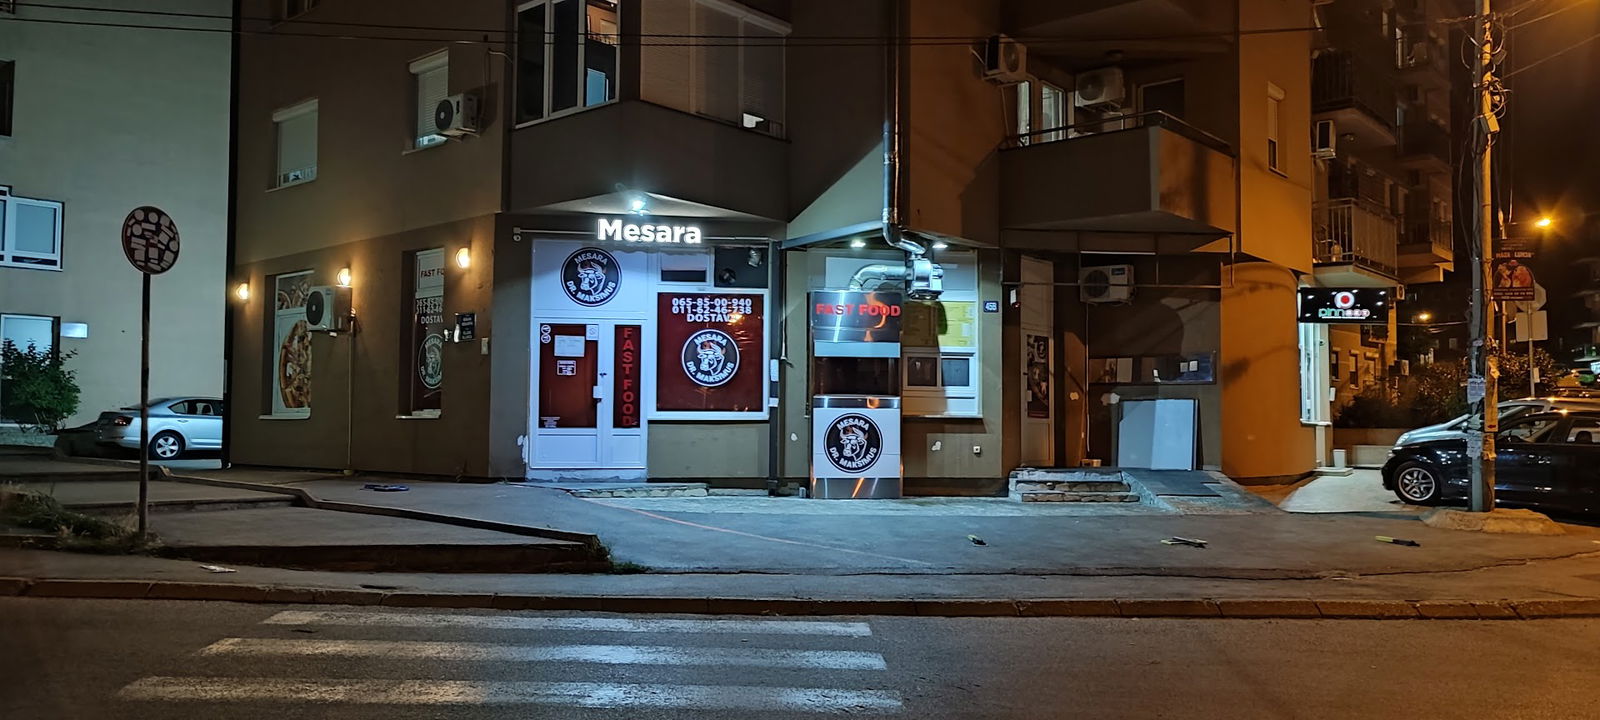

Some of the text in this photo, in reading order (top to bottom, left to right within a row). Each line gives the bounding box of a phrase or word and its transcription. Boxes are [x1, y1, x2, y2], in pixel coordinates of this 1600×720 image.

[597, 218, 702, 244] Mesara
[574, 253, 608, 265] MESARA
[421, 268, 435, 278] FAST
[566, 281, 616, 302] DR. MAKSIMUS
[672, 298, 752, 306] 065-85-00-940
[672, 306, 752, 314] 011-62-46-738
[816, 303, 901, 316] FAST FOOD
[687, 314, 736, 322] DOSTAV
[694, 333, 728, 346] MESARA
[622, 327, 634, 426] FAST FOOD
[686, 361, 735, 382] DR. MAKSIMUS
[836, 418, 870, 431] MESARA
[829, 447, 878, 468] DR. MAKSIMUS
